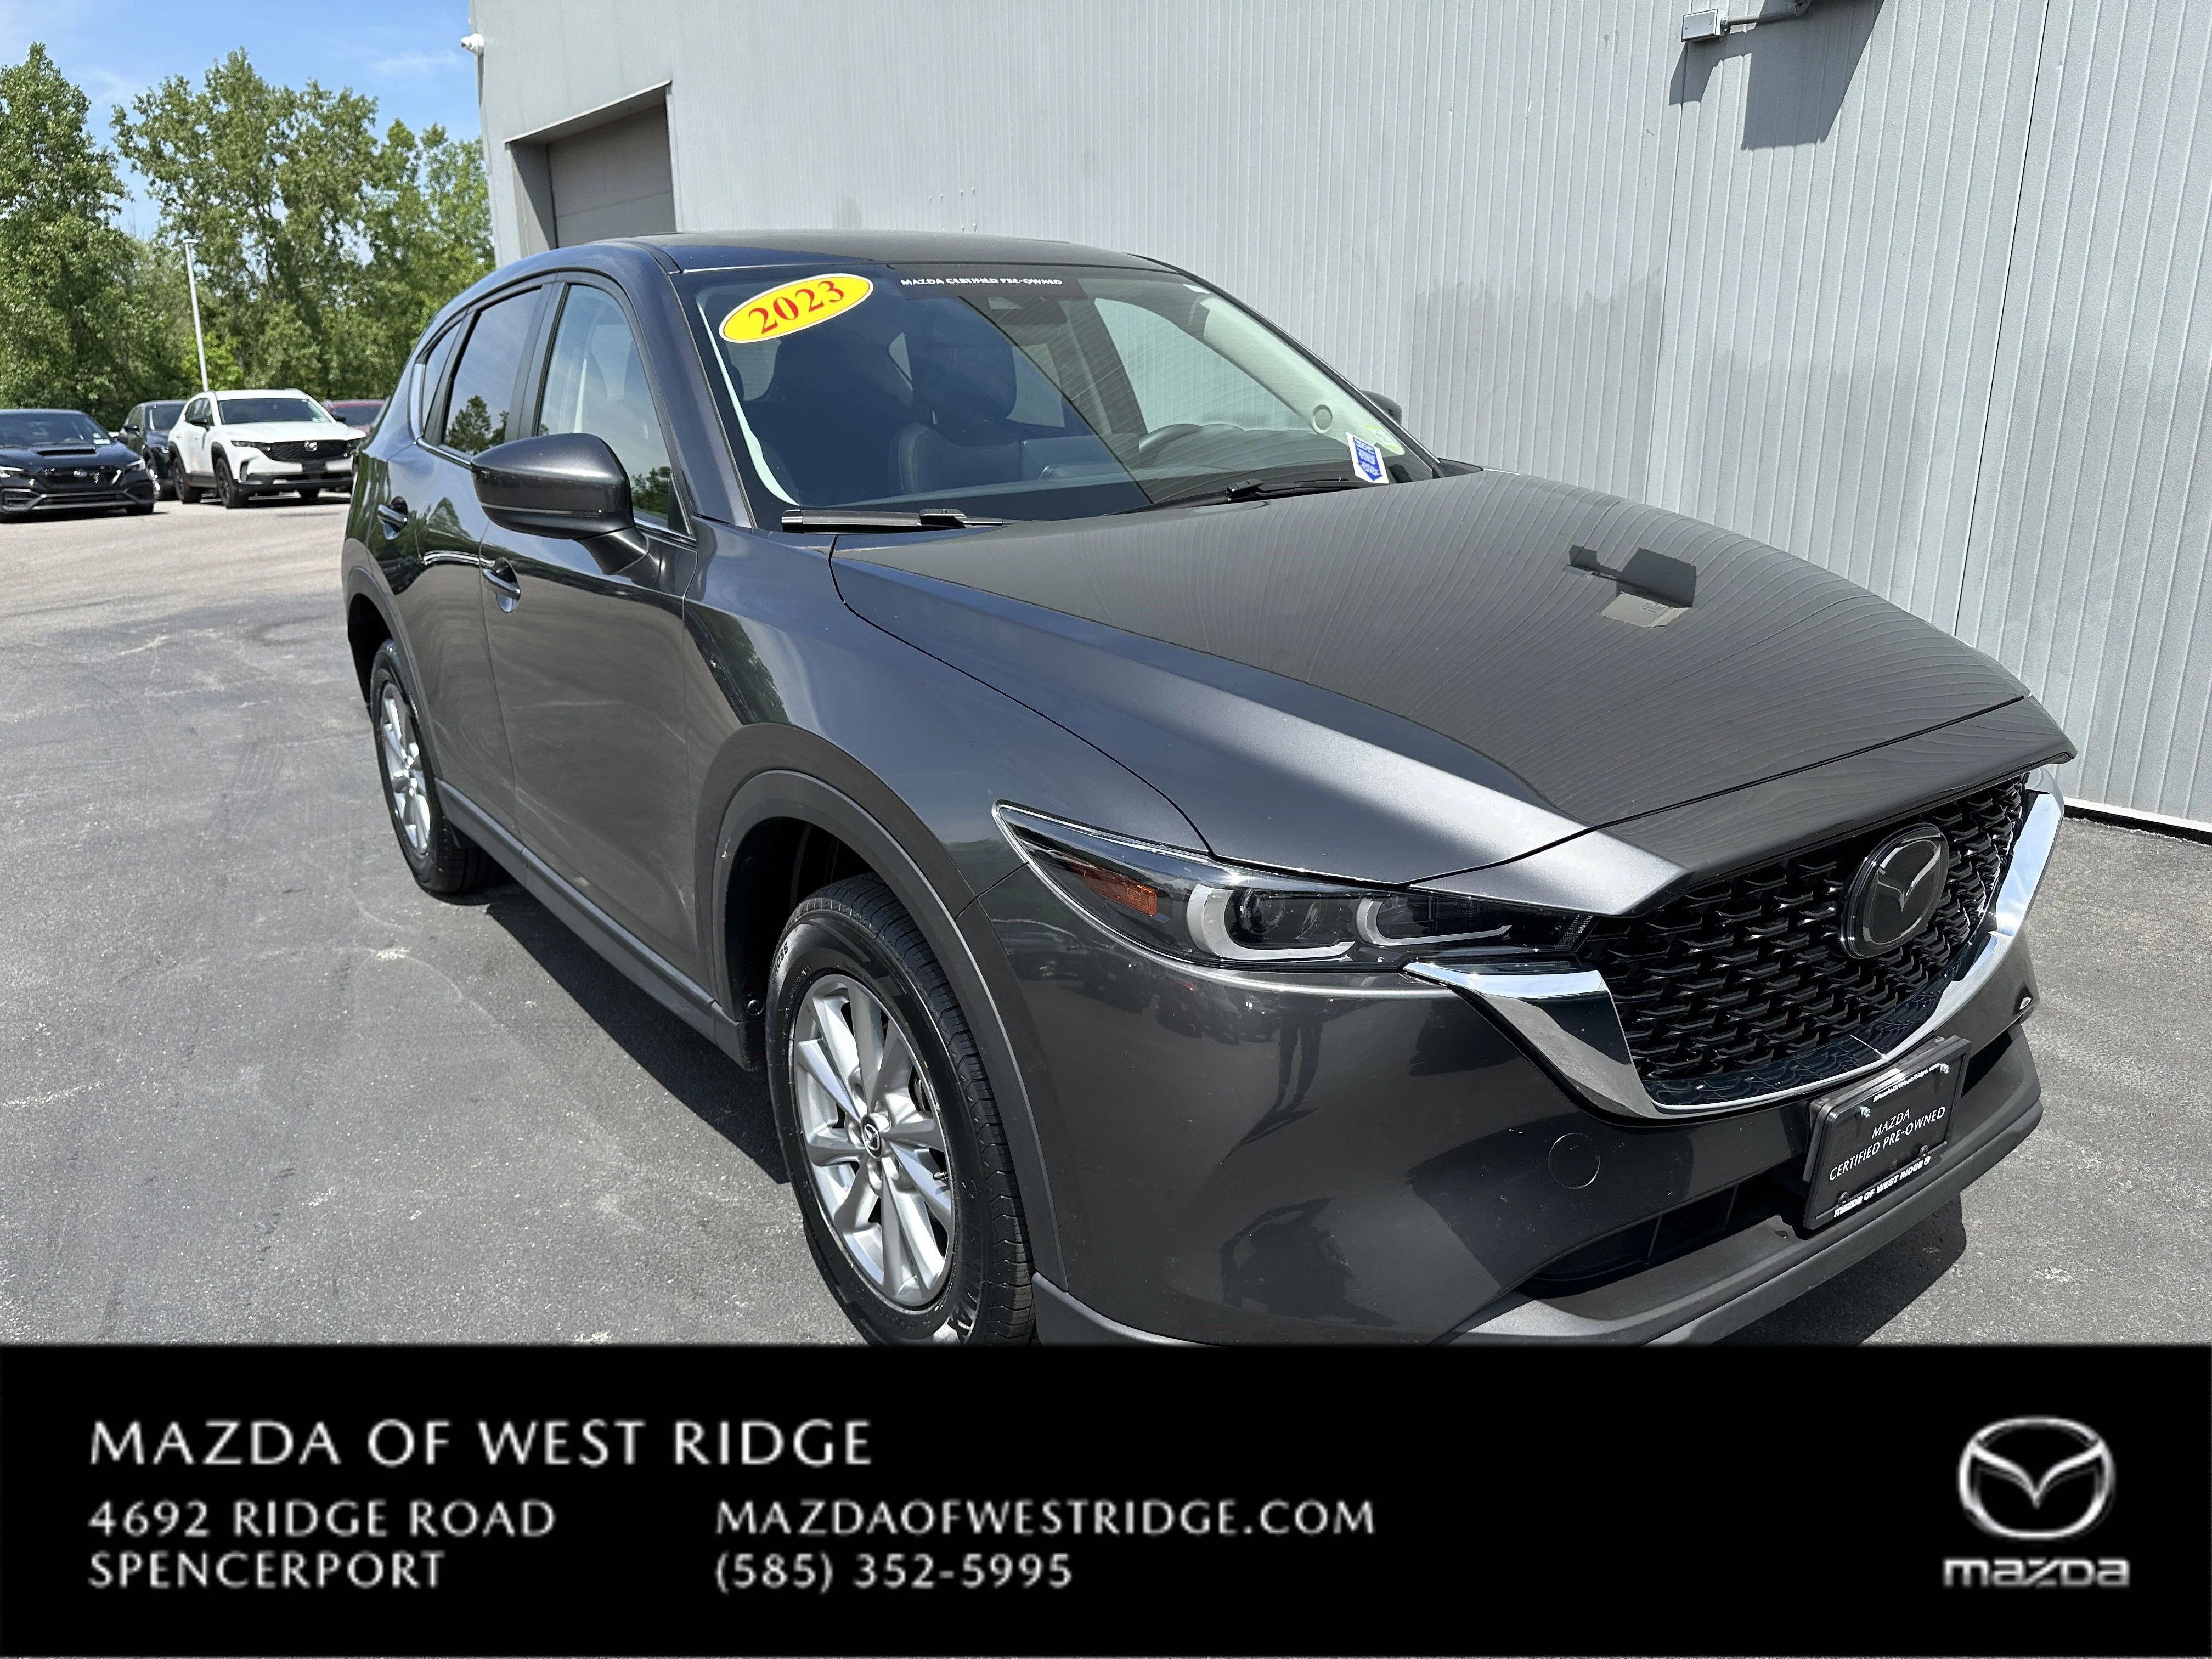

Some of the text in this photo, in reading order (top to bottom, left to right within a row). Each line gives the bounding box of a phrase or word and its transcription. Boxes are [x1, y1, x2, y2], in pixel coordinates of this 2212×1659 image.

[748, 280, 845, 335] 2023
[1829, 1106, 1946, 1181] CERTIFIED PRE-OWNED
[1871, 1108, 1911, 1139] MAZDA
[1864, 1188, 1876, 1201] OF
[1876, 1174, 1900, 1194] WEST
[1899, 1159, 1924, 1181] RIDGE
